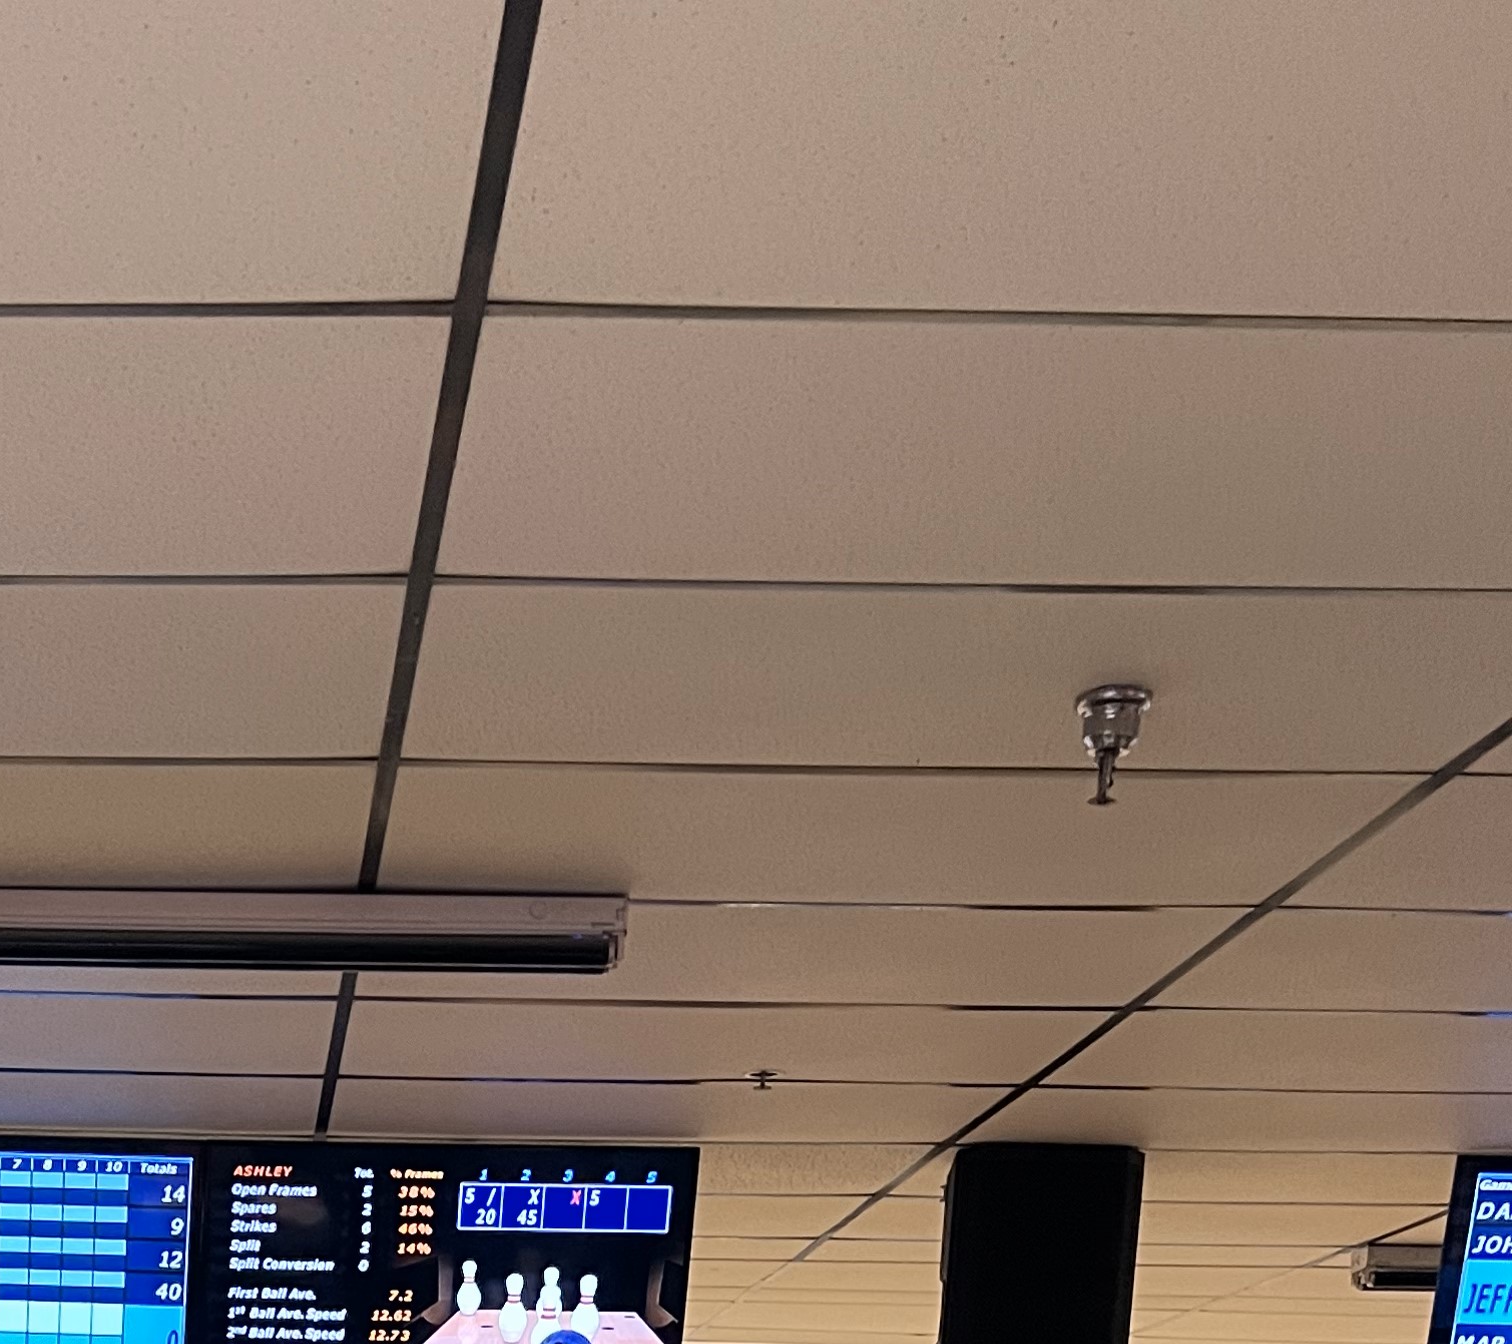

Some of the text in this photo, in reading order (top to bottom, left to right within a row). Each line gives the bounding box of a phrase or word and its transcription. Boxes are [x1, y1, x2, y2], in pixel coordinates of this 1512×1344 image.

[140, 1163, 178, 1175] Totals
[233, 1165, 293, 1178] ASHLEY
[231, 1183, 267, 1198] Open
[269, 1183, 318, 1197] Frames
[1480, 1180, 1512, 1191] Gam
[161, 1185, 186, 1203] 14
[528, 1188, 540, 1205] X
[570, 1190, 582, 1206] X
[589, 1190, 601, 1206] 5
[231, 1201, 277, 1216] Spares
[1476, 1202, 1512, 1220] DA
[475, 1209, 538, 1226] 20 45
[170, 1218, 185, 1236] 9
[230, 1219, 277, 1233] Strikes
[229, 1239, 261, 1253] Split
[158, 1251, 183, 1269] 12
[229, 1257, 335, 1271] Split Conversion
[155, 1283, 182, 1301] 40
[227, 1286, 259, 1300] First
[261, 1287, 287, 1300] Ball
[388, 1290, 414, 1302] 7.2
[249, 1307, 275, 1320] Ball
[305, 1308, 347, 1322] Speed
[248, 1326, 275, 1339] Ball
[304, 1327, 345, 1342] Speed
